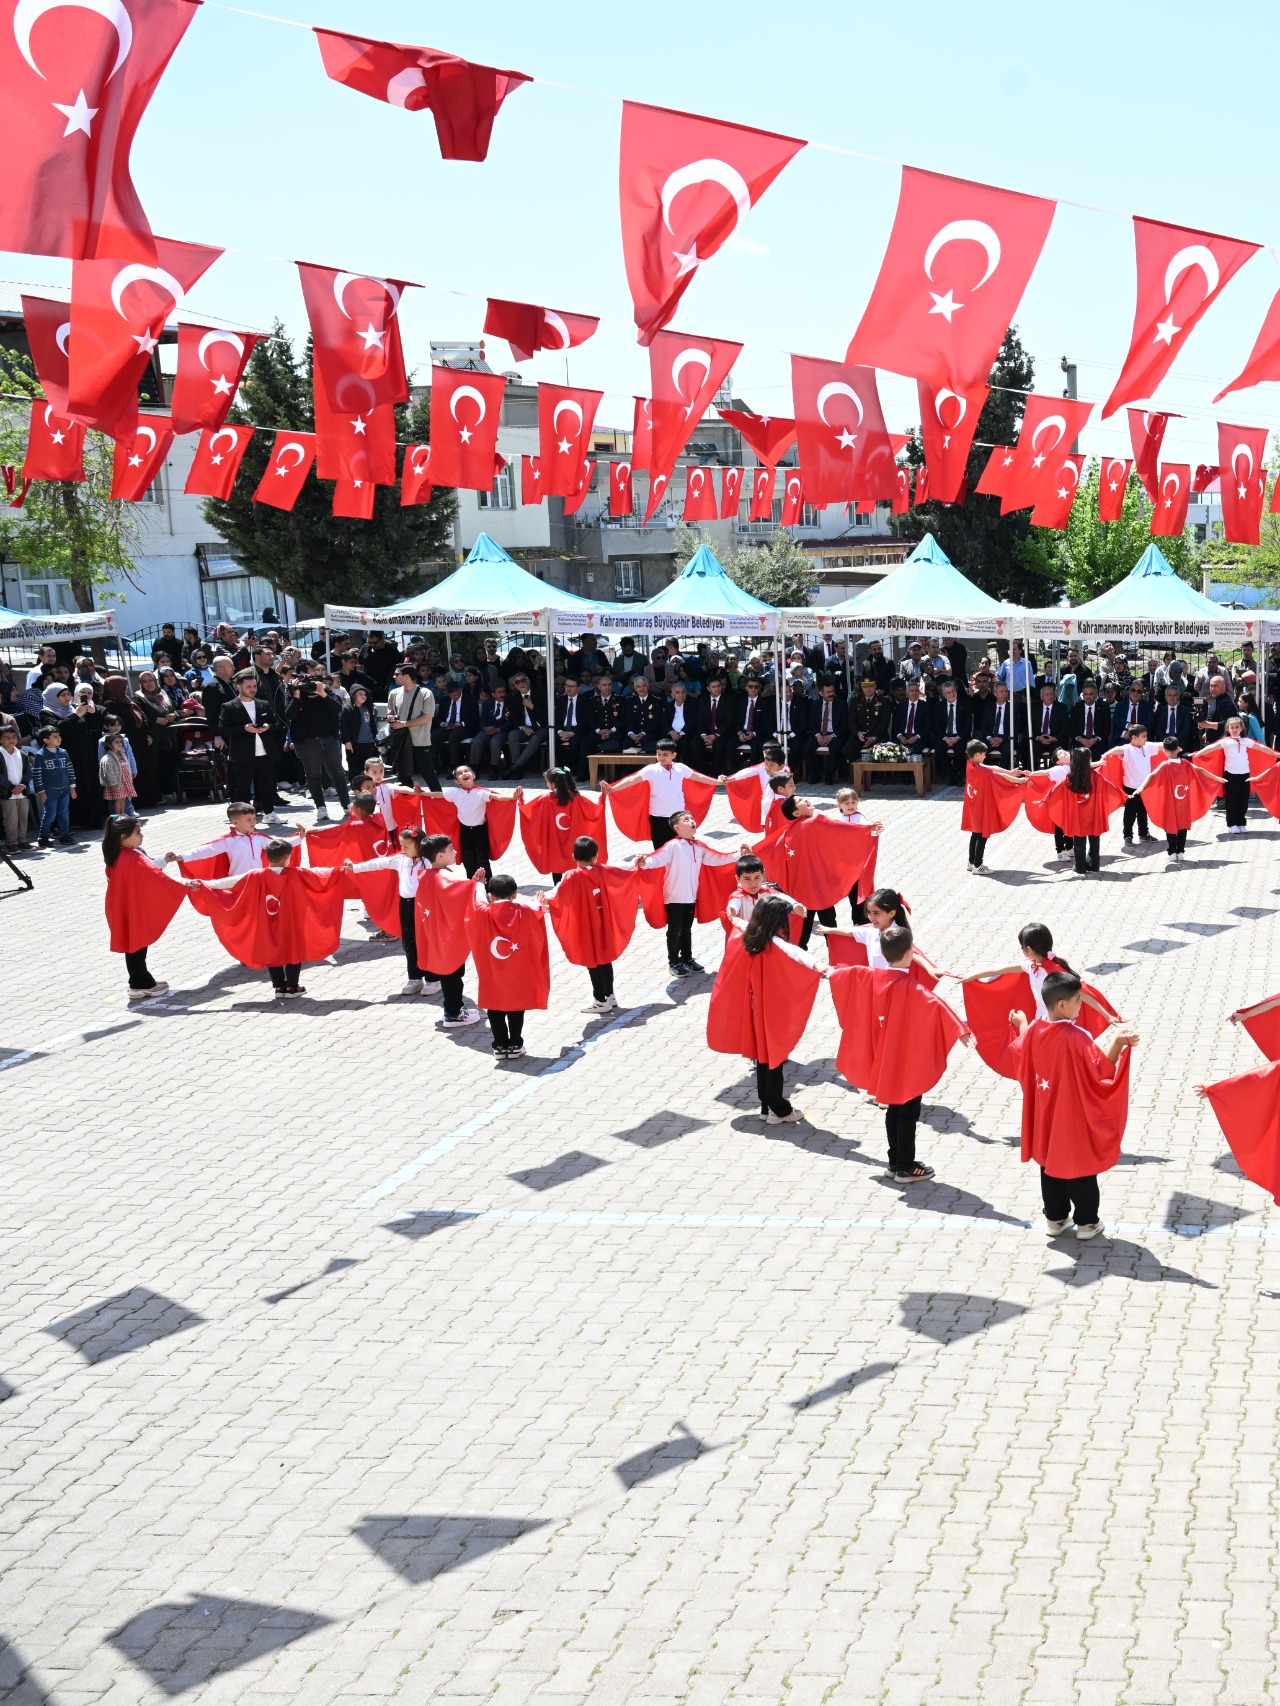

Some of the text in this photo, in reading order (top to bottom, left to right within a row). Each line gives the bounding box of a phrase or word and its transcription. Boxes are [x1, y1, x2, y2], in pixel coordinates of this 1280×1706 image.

[373, 612, 499, 628] Kahramanmaraş Büyükşehir Belediyesi
[600, 615, 725, 631] Kahramanmaraş Büyükşehir Belediyesi
[831, 617, 886, 629] Kahramanmaraş
[887, 615, 925, 631] Büyükşehir
[22, 622, 53, 640] Büyükşehir
[1077, 621, 1210, 637] Kahramanmaraş Büyükşehir Belediyesi
